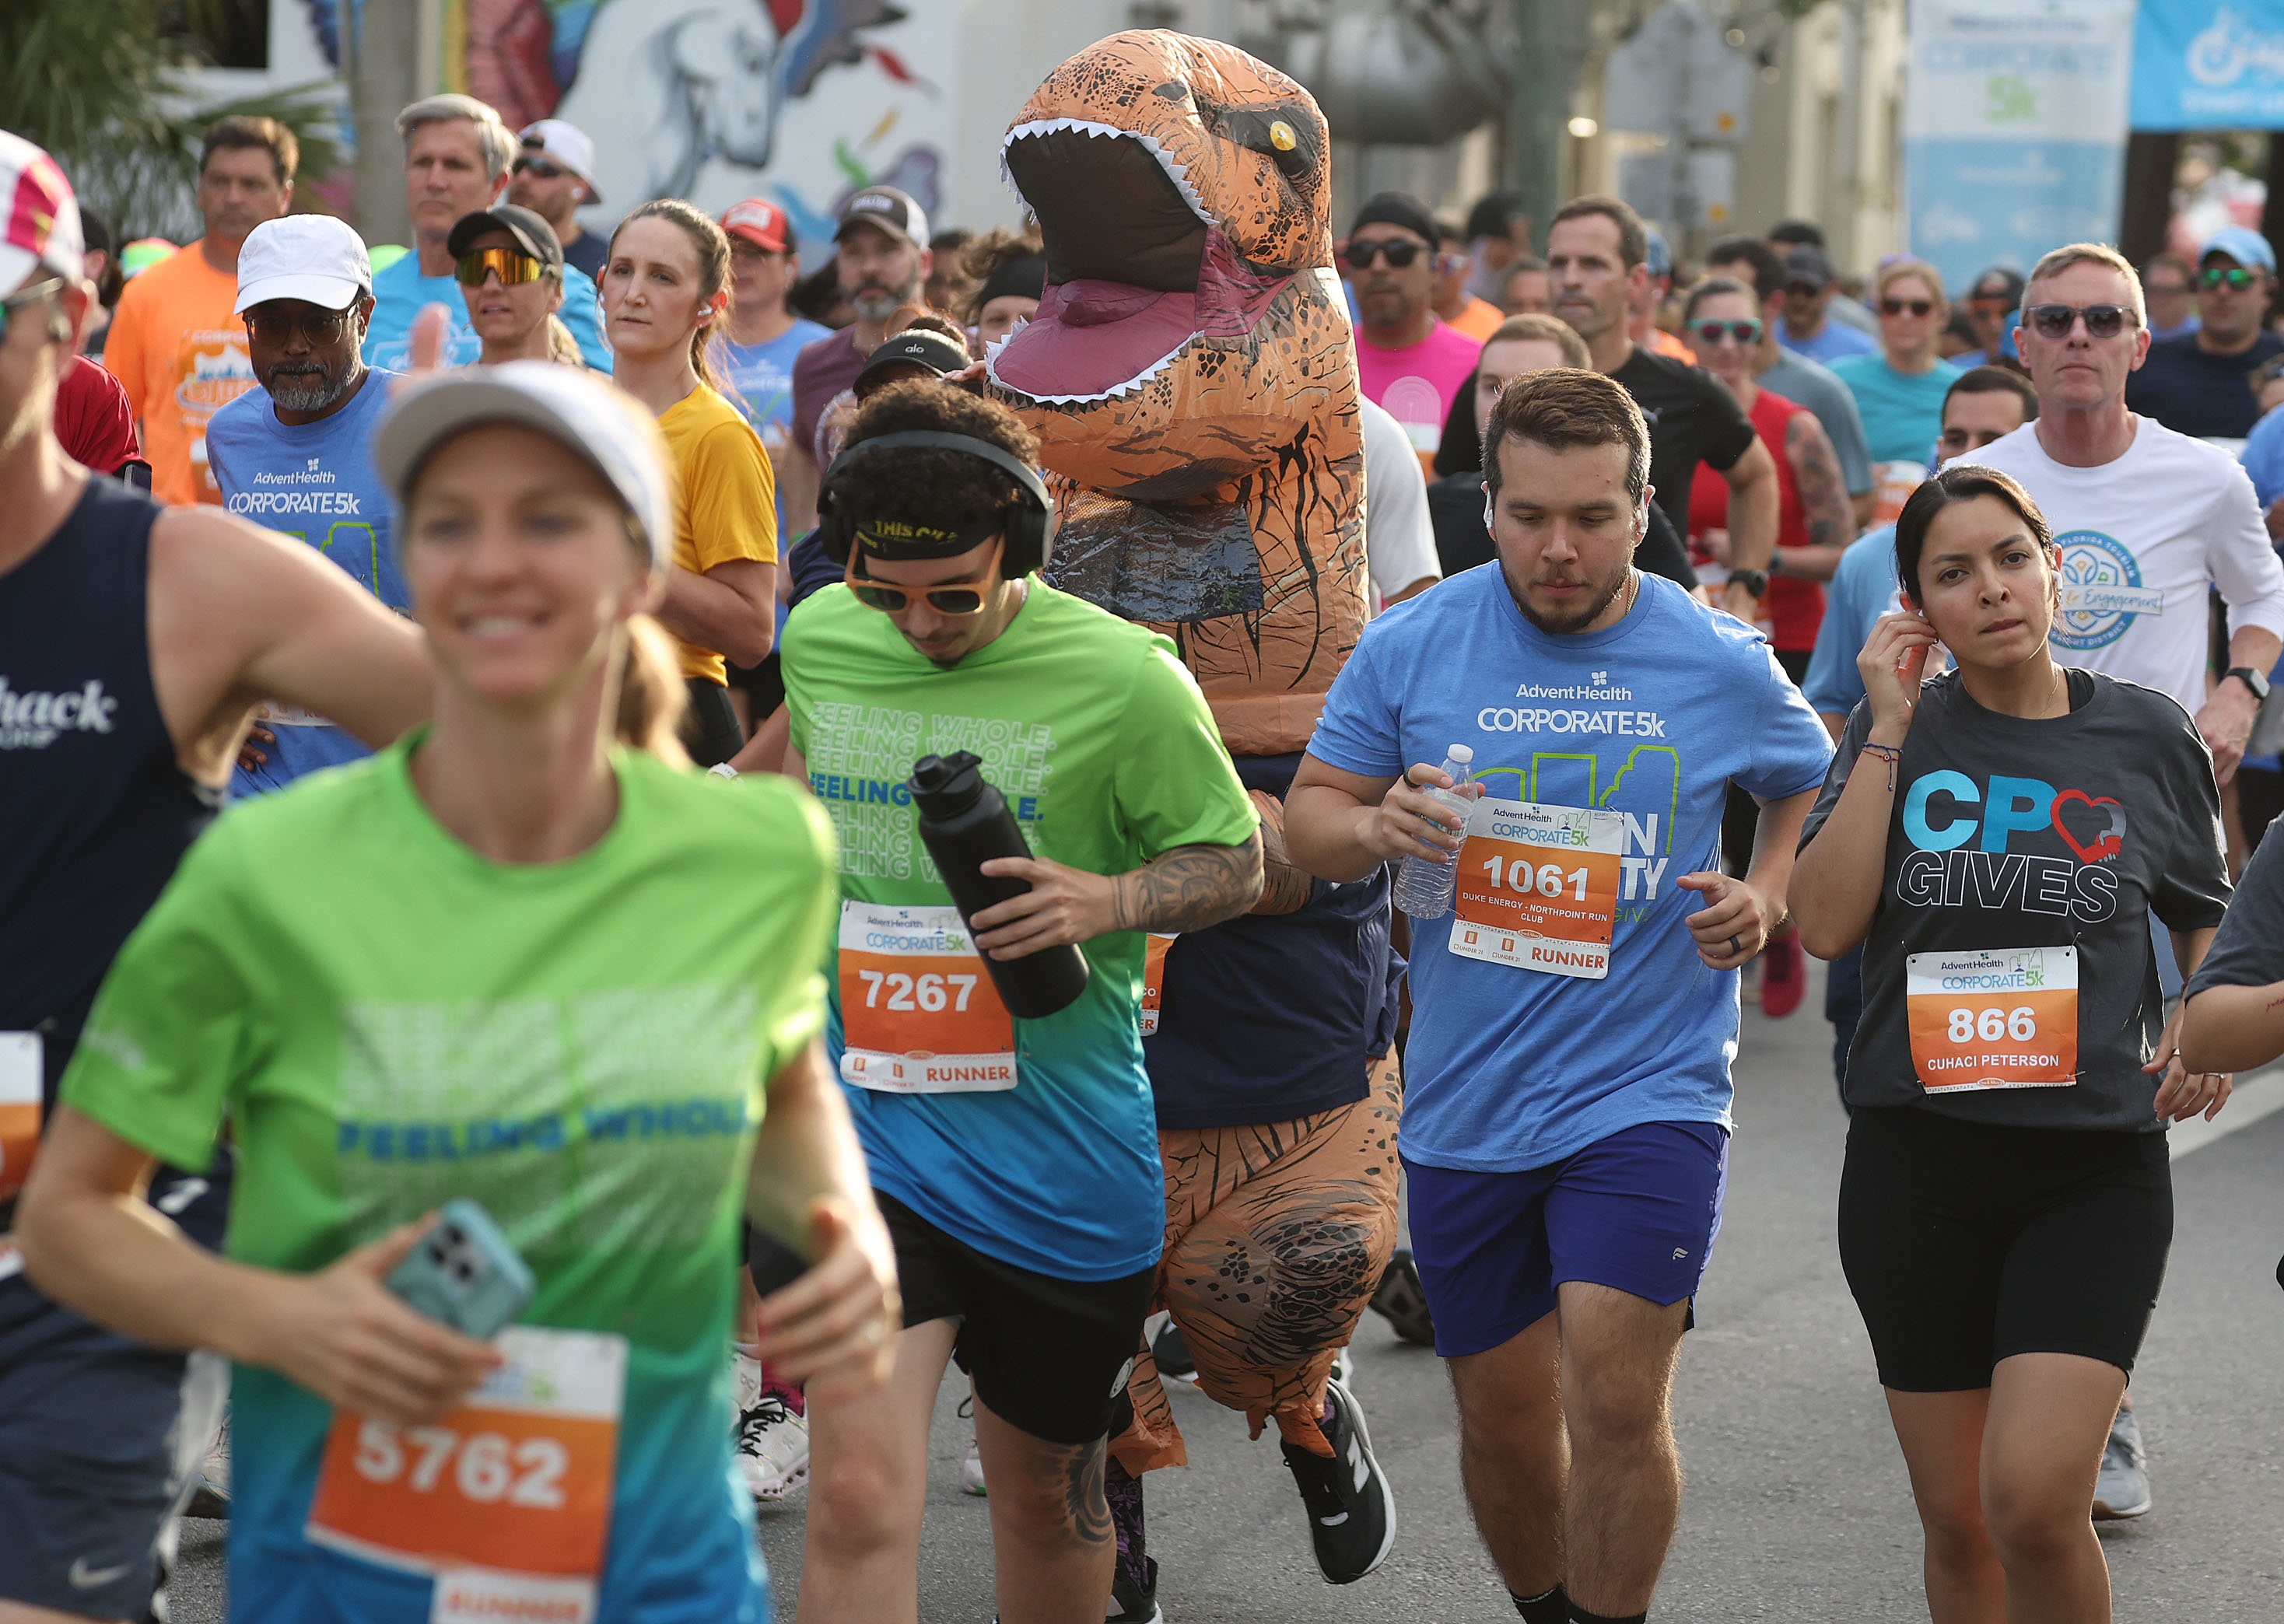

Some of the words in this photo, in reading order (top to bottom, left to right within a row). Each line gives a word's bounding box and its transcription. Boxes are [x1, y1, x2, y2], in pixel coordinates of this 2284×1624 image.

[905, 343, 924, 354] alo
[253, 471, 336, 485] AdventHealth
[1516, 684, 1632, 701] AdventHealth
[1477, 707, 1666, 738] CORPORATE5k
[1493, 808, 1553, 824] AdventHealth
[1483, 855, 1589, 901] 1061
[1897, 849, 2119, 924] GIVES
[1463, 892, 1487, 903] DUKE
[1488, 896, 1523, 909] ENERGY
[1529, 904, 1585, 919] NORTHPOINT
[1589, 912, 1608, 922] RUN
[1521, 913, 1543, 924] CLUB
[1459, 945, 1477, 954] UNDER
[1531, 947, 1605, 969] RUNNER
[1941, 959, 2004, 970] AdventHealth
[859, 969, 977, 1012] 7267
[1947, 1006, 2036, 1043] 866
[1928, 1056, 1977, 1070] CUHACI
[1981, 1055, 2059, 1066] PETERSON
[927, 1066, 1011, 1082] RUNNER
[353, 1416, 569, 1510] 5762
